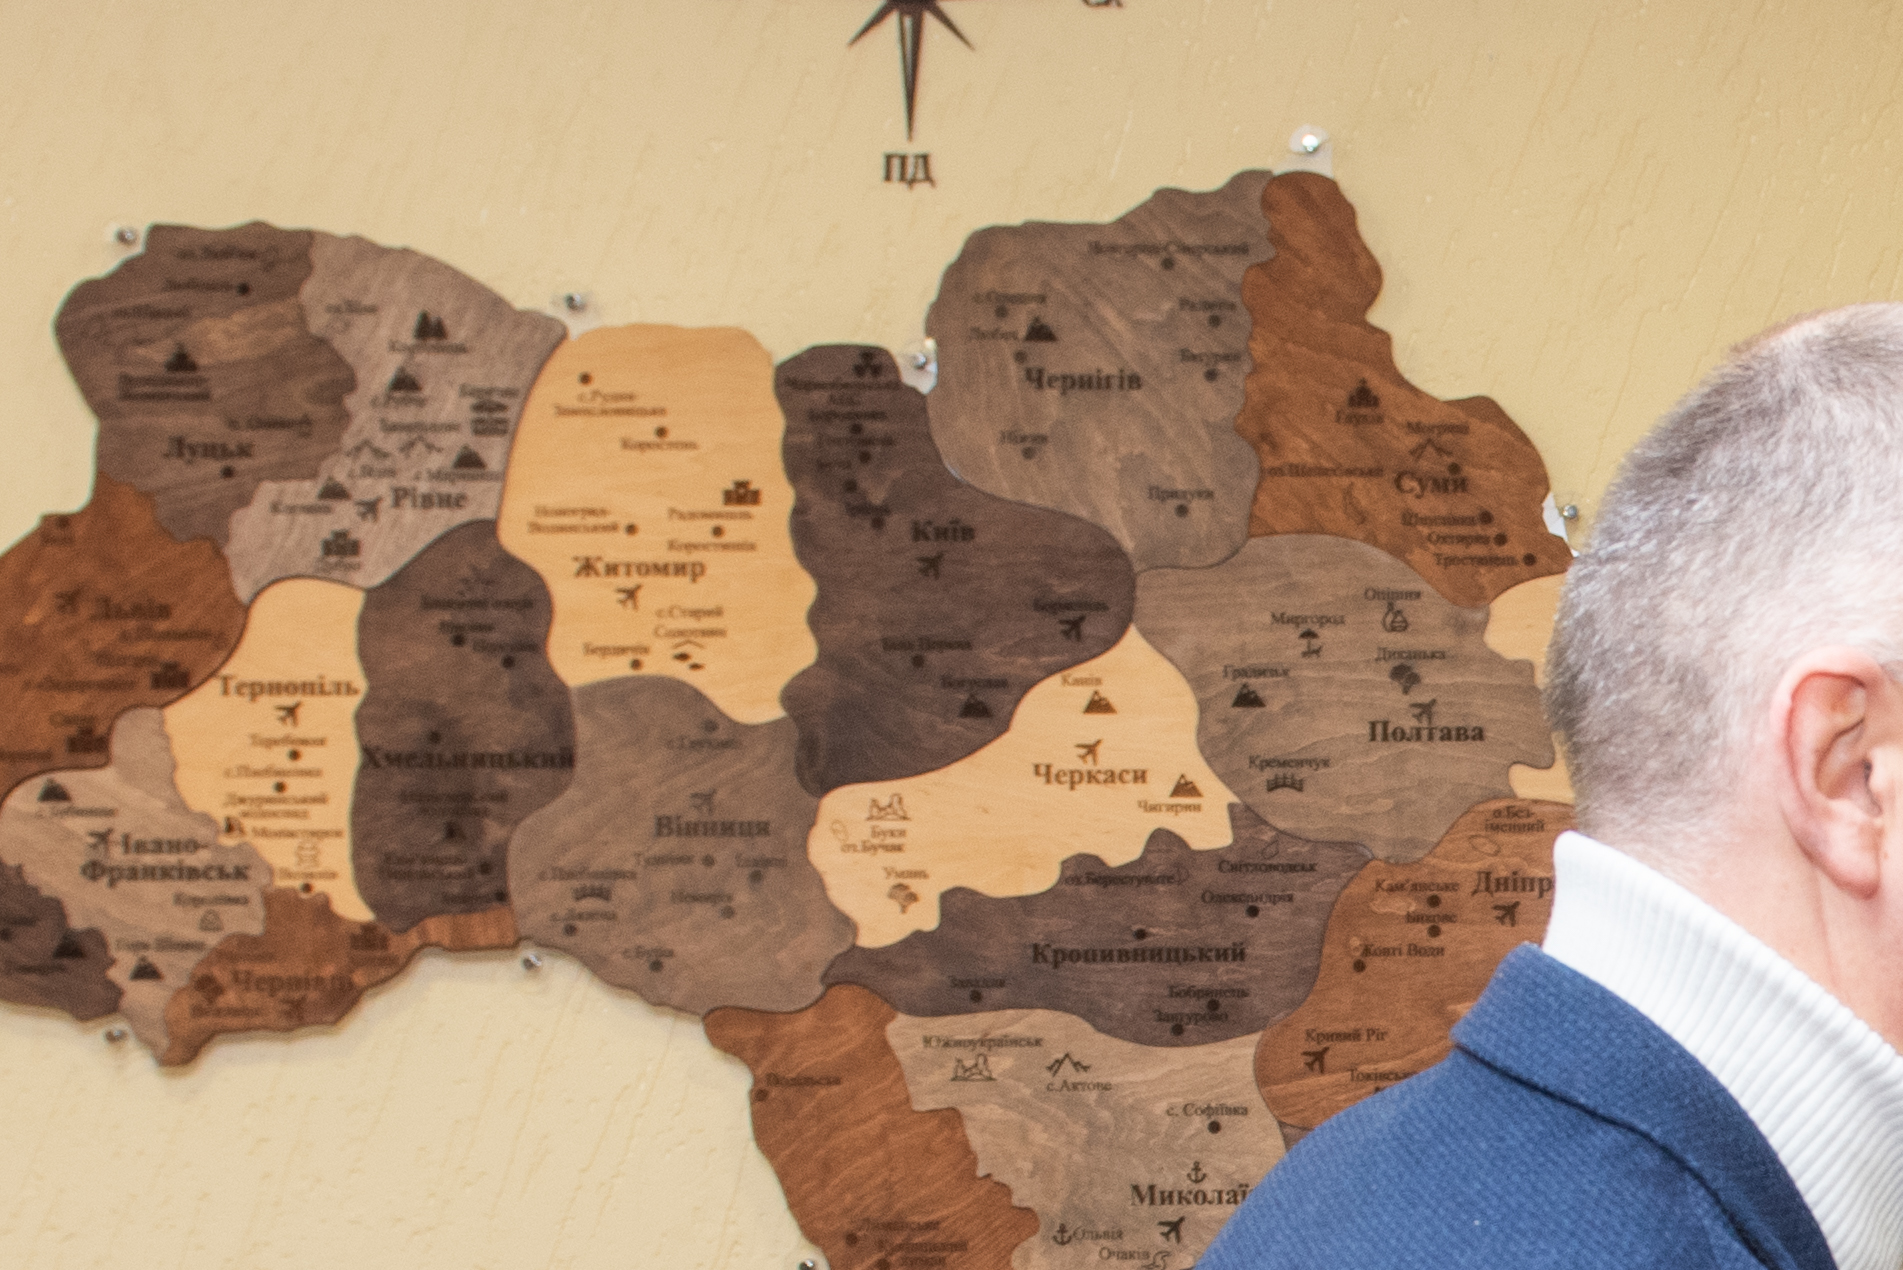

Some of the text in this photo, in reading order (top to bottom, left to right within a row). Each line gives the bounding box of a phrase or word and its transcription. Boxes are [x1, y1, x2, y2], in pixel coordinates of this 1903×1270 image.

[883, 152, 936, 190] ПД
[1025, 367, 1142, 395] Чернігів
[1394, 470, 1468, 498] Суми
[390, 486, 468, 510] Рівне
[911, 519, 976, 543] Київ
[572, 555, 706, 583] Житомир
[1271, 612, 1345, 628] Миргород
[219, 674, 360, 701] Тернопіль
[1368, 720, 1484, 743] Полтава
[1249, 756, 1331, 772] Кременчук
[1032, 763, 1149, 790] Черкаси
[1137, 800, 1203, 816] Чигирин
[654, 814, 771, 840] Вінниця
[81, 859, 251, 889] Франківськ
[883, 866, 930, 880] Умань
[1472, 870, 1553, 899] Дніпр
[1031, 942, 1247, 968] Кропивницький
[1408, 943, 1445, 957] Води
[922, 1034, 1044, 1051] Южноукраїнськ
[1305, 1028, 1388, 1044] Кривий Ріг
[1183, 1103, 1249, 1119] Софіївка
[1130, 1184, 1252, 1207] Миколаї
[1099, 1247, 1150, 1261] Очаків
